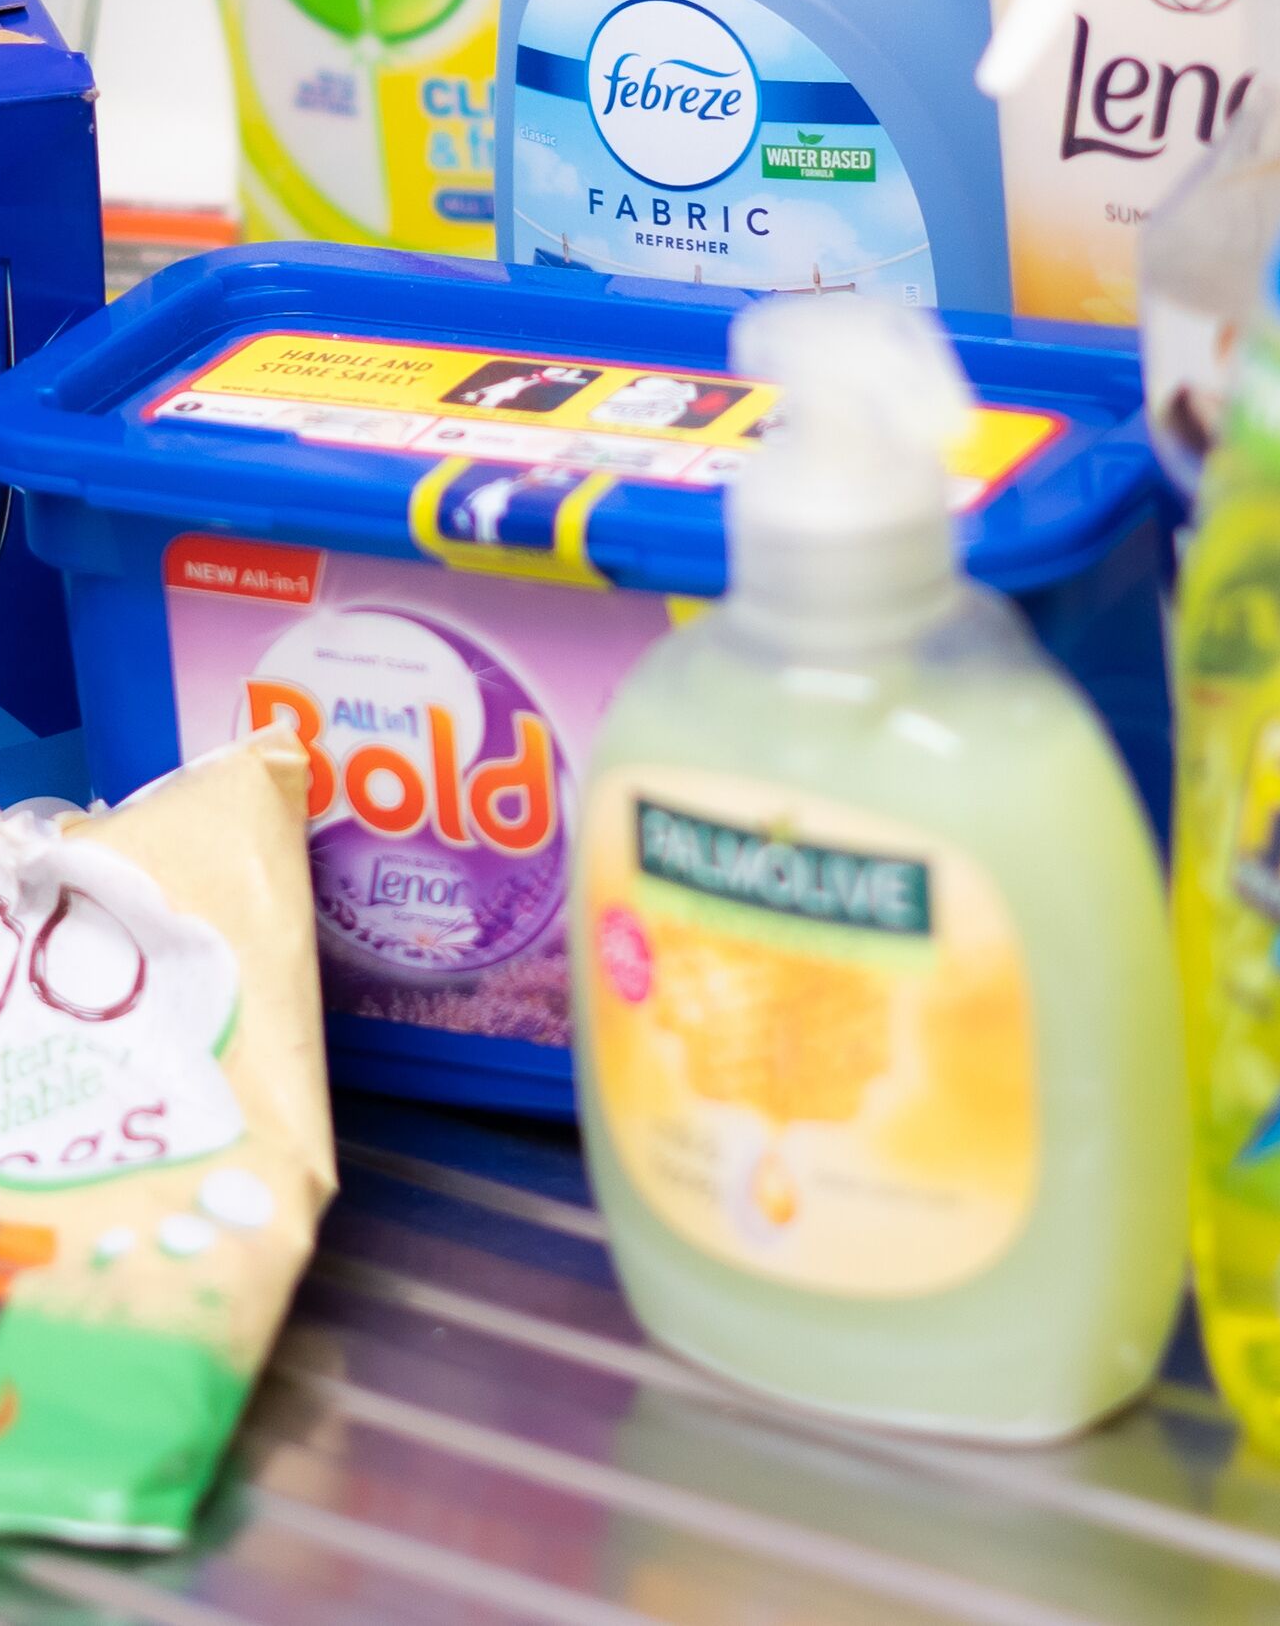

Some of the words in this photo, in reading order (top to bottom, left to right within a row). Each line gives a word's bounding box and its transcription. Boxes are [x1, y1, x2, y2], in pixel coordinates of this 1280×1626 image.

[603, 51, 743, 122] febreze
[520, 125, 557, 147] classic
[766, 147, 818, 168] WATER
[821, 150, 871, 170] BASED
[800, 169, 835, 179] FORMULA
[587, 187, 772, 237] FABRIC
[634, 231, 730, 256] REFRESHER
[279, 349, 376, 370] HANDLE
[378, 359, 434, 373] AND
[255, 362, 334, 379] STORE
[335, 369, 424, 387] SAFELY
[184, 561, 237, 584] NEW
[332, 697, 378, 732] All
[246, 677, 562, 856] Bold
[640, 806, 915, 928] PALMOLIVE
[370, 857, 471, 906] Lenor
